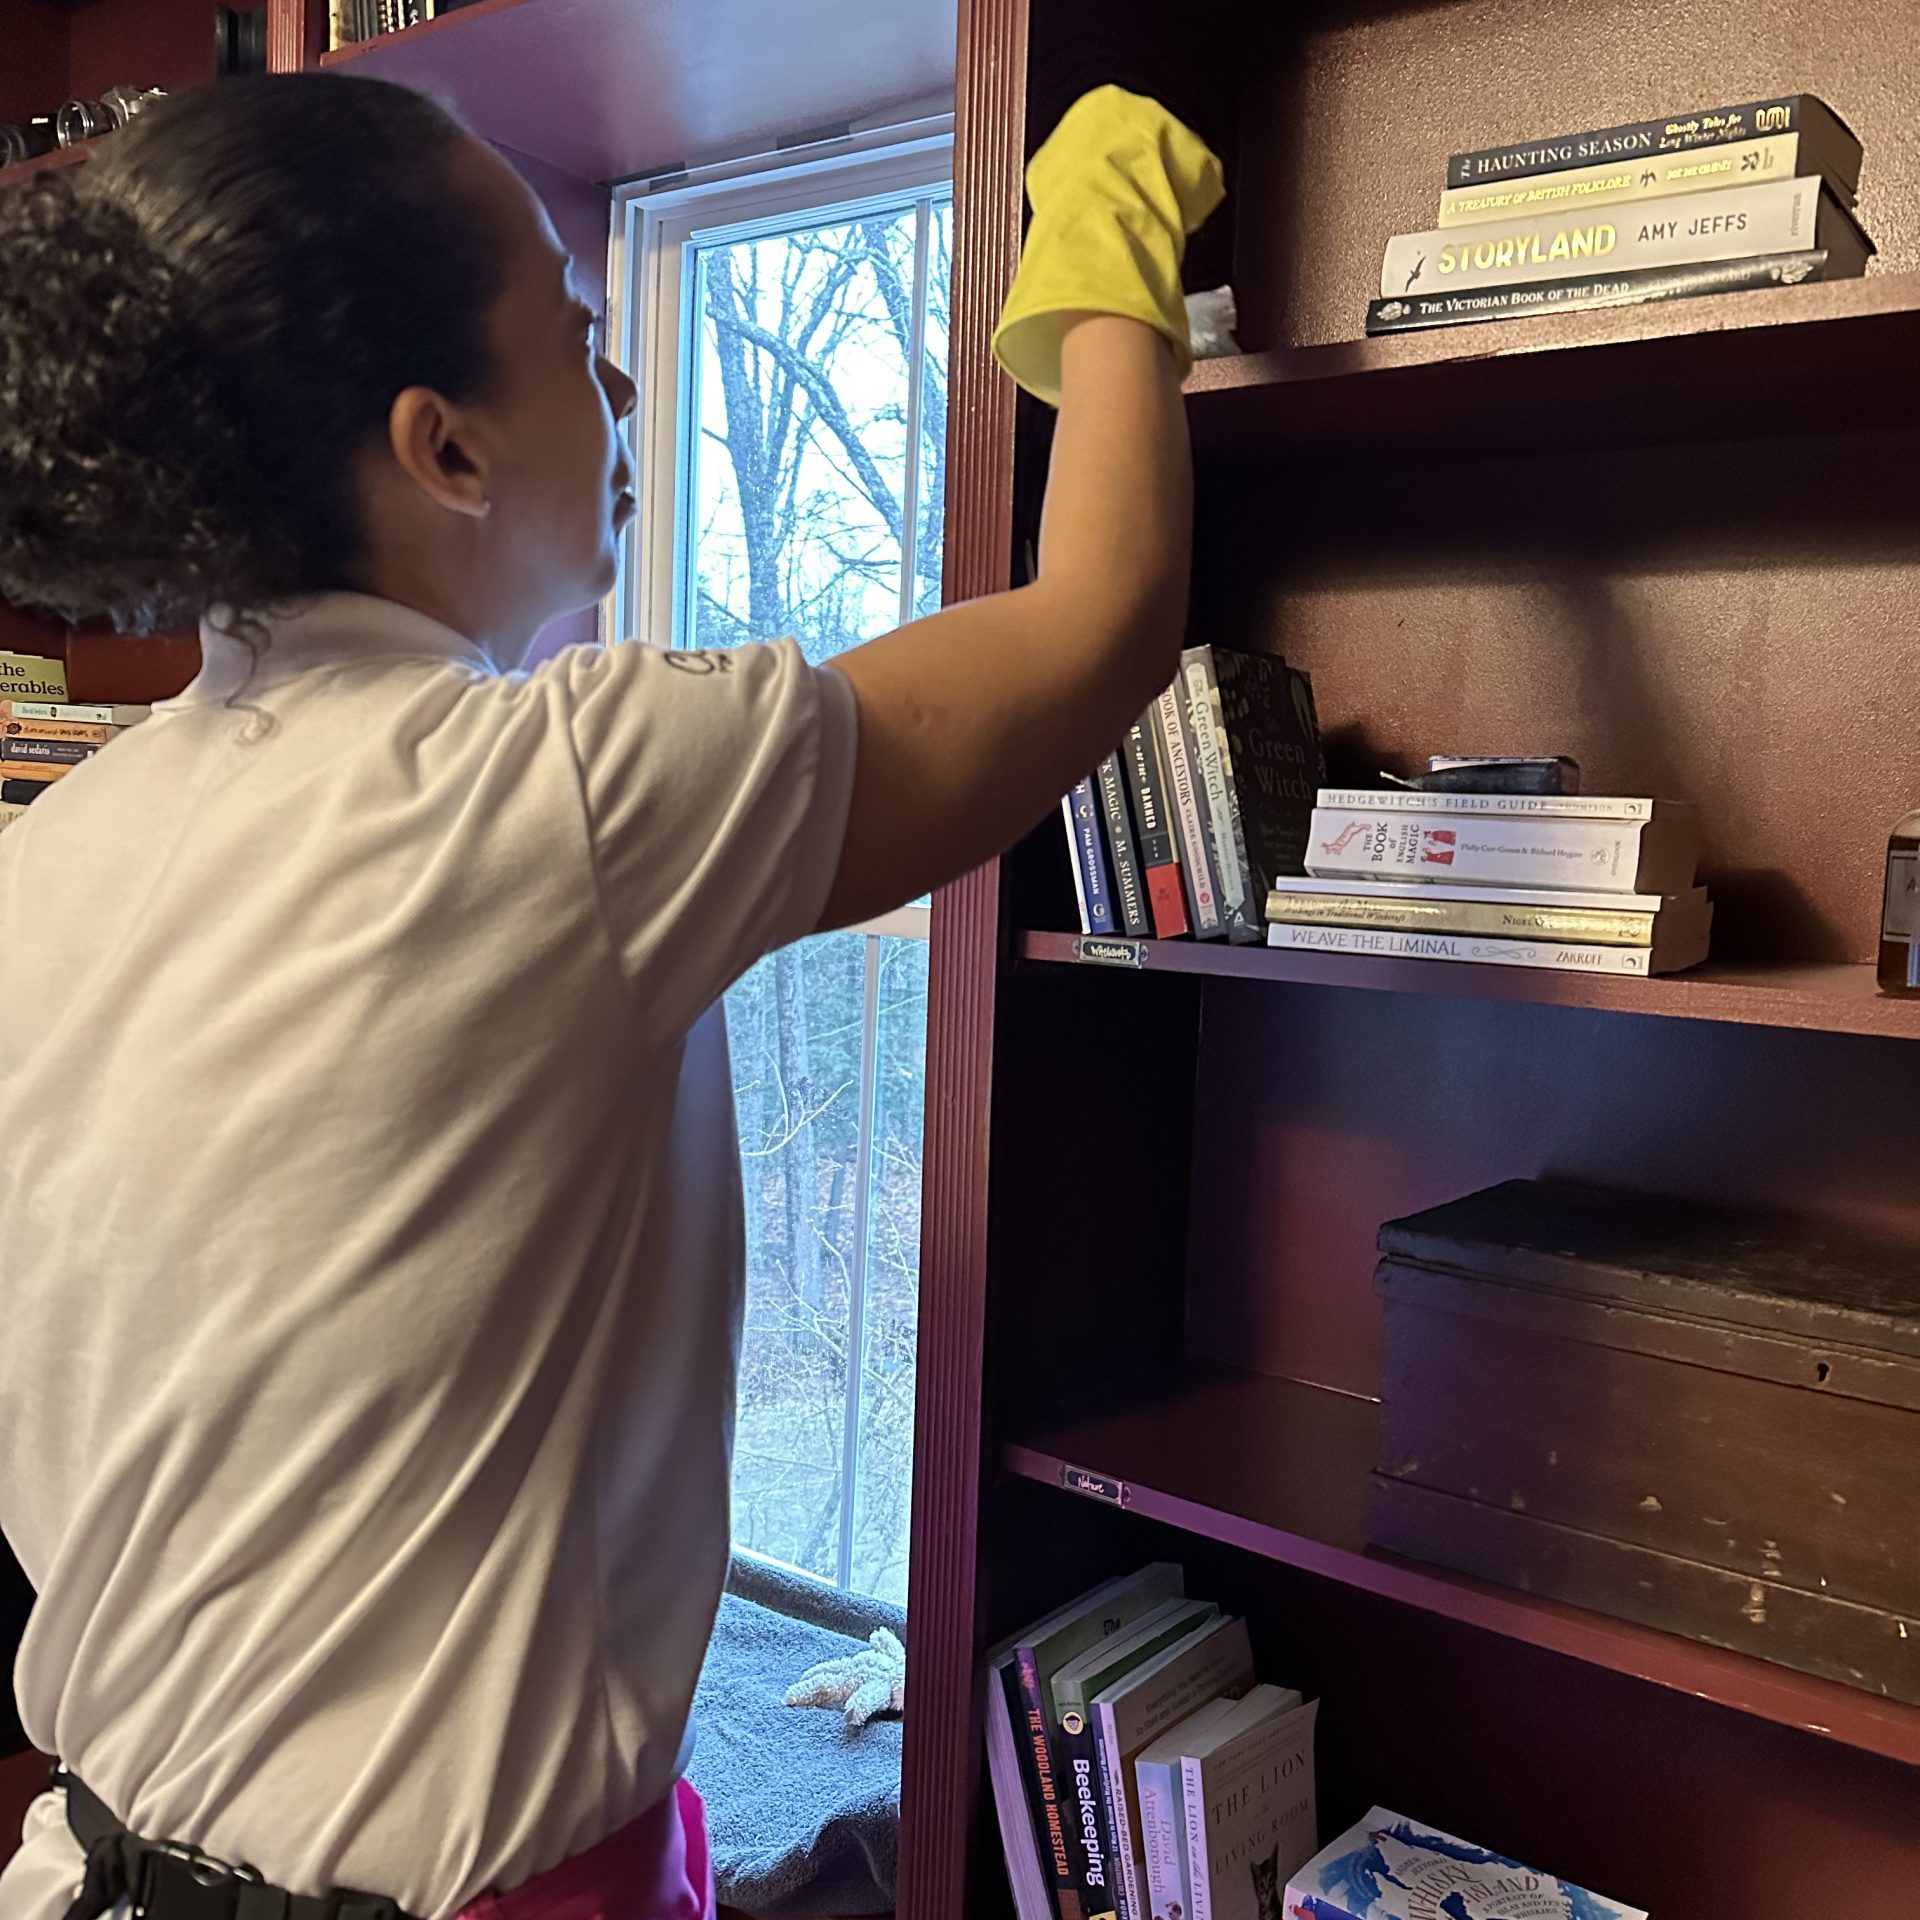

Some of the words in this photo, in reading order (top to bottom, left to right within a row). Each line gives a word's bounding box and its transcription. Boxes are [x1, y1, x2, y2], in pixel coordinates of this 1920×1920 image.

[1478, 146, 1572, 173] HAUNTING
[1578, 132, 1652, 157] SEASON
[1446, 202, 1456, 214] A
[1459, 193, 1512, 211] TREASURY
[1513, 192, 1527, 205] OF
[1527, 185, 1571, 202] BRITISH
[1571, 175, 1632, 196] FOLKLORE
[1438, 224, 1616, 274] STORYLAND
[1638, 222, 1678, 242] AMY
[1689, 213, 1747, 236] JEFFS
[1446, 296, 1509, 312] VICTORIAN
[1511, 291, 1544, 304] BOOK
[1547, 289, 1564, 300] OF
[1567, 286, 1589, 298] THE
[1593, 282, 1629, 296] DEAD
[0, 662, 25, 676] he
[0, 680, 65, 695] erables
[1162, 689, 1175, 720] OOK
[1167, 722, 1179, 736] OF
[1196, 702, 1212, 751] Green
[1249, 727, 1306, 764] Green
[11, 743, 28, 754] david
[29, 743, 50, 756] sedaris
[1170, 741, 1192, 806] ANCESTORS
[1203, 752, 1223, 801] Witch
[1253, 763, 1313, 801] Witch
[1104, 777, 1121, 821] MAGIC
[1328, 794, 1438, 807] HEDGEWITCH'S
[1446, 797, 1490, 809] FIELD
[1497, 800, 1550, 811] GUIDE
[1082, 828, 1092, 846] PAM
[1186, 809, 1196, 839] CLAIRE
[1363, 833, 1373, 851] THE
[1371, 822, 1388, 862] BOOK
[1396, 824, 1409, 862] ENGLISH
[1115, 840, 1126, 857] M.
[1389, 838, 1398, 849] of
[1406, 823, 1420, 864] MAGIC
[1460, 843, 1480, 853] Philip
[1530, 847, 1556, 857] Richard
[1085, 849, 1099, 895] GROSSMAN
[1119, 861, 1140, 926] SUMMERS
[1326, 909, 1365, 919] Traditional
[1367, 911, 1406, 924] Witchcraft
[1292, 928, 1348, 947] WEAVE
[1352, 934, 1385, 950] THE
[1389, 936, 1460, 956] LIMINAL
[1556, 951, 1602, 966] ZAKROFF
[1028, 1709, 1043, 1731] THE
[1033, 1736, 1055, 1800] WOODLAND
[1185, 1767, 1196, 1798] THE
[1212, 1786, 1249, 1826] THE
[1261, 1750, 1306, 1794] LION
[1045, 1804, 1069, 1876] HOMESTEAD
[1073, 1759, 1105, 1887] Beekeeping
[1144, 1787, 1167, 1893] Attenborough
[1188, 1804, 1199, 1842] LION
[1215, 1830, 1265, 1876] LIVING
[1272, 1797, 1310, 1833] ROOM
[1115, 1789, 1129, 1851] RAISED-BED
[1124, 1854, 1138, 1916] GARDENING
[1161, 1820, 1176, 1866] David
[1408, 1863, 1483, 1920] WHISKY
[1463, 1876, 1539, 1903] ISLAND
